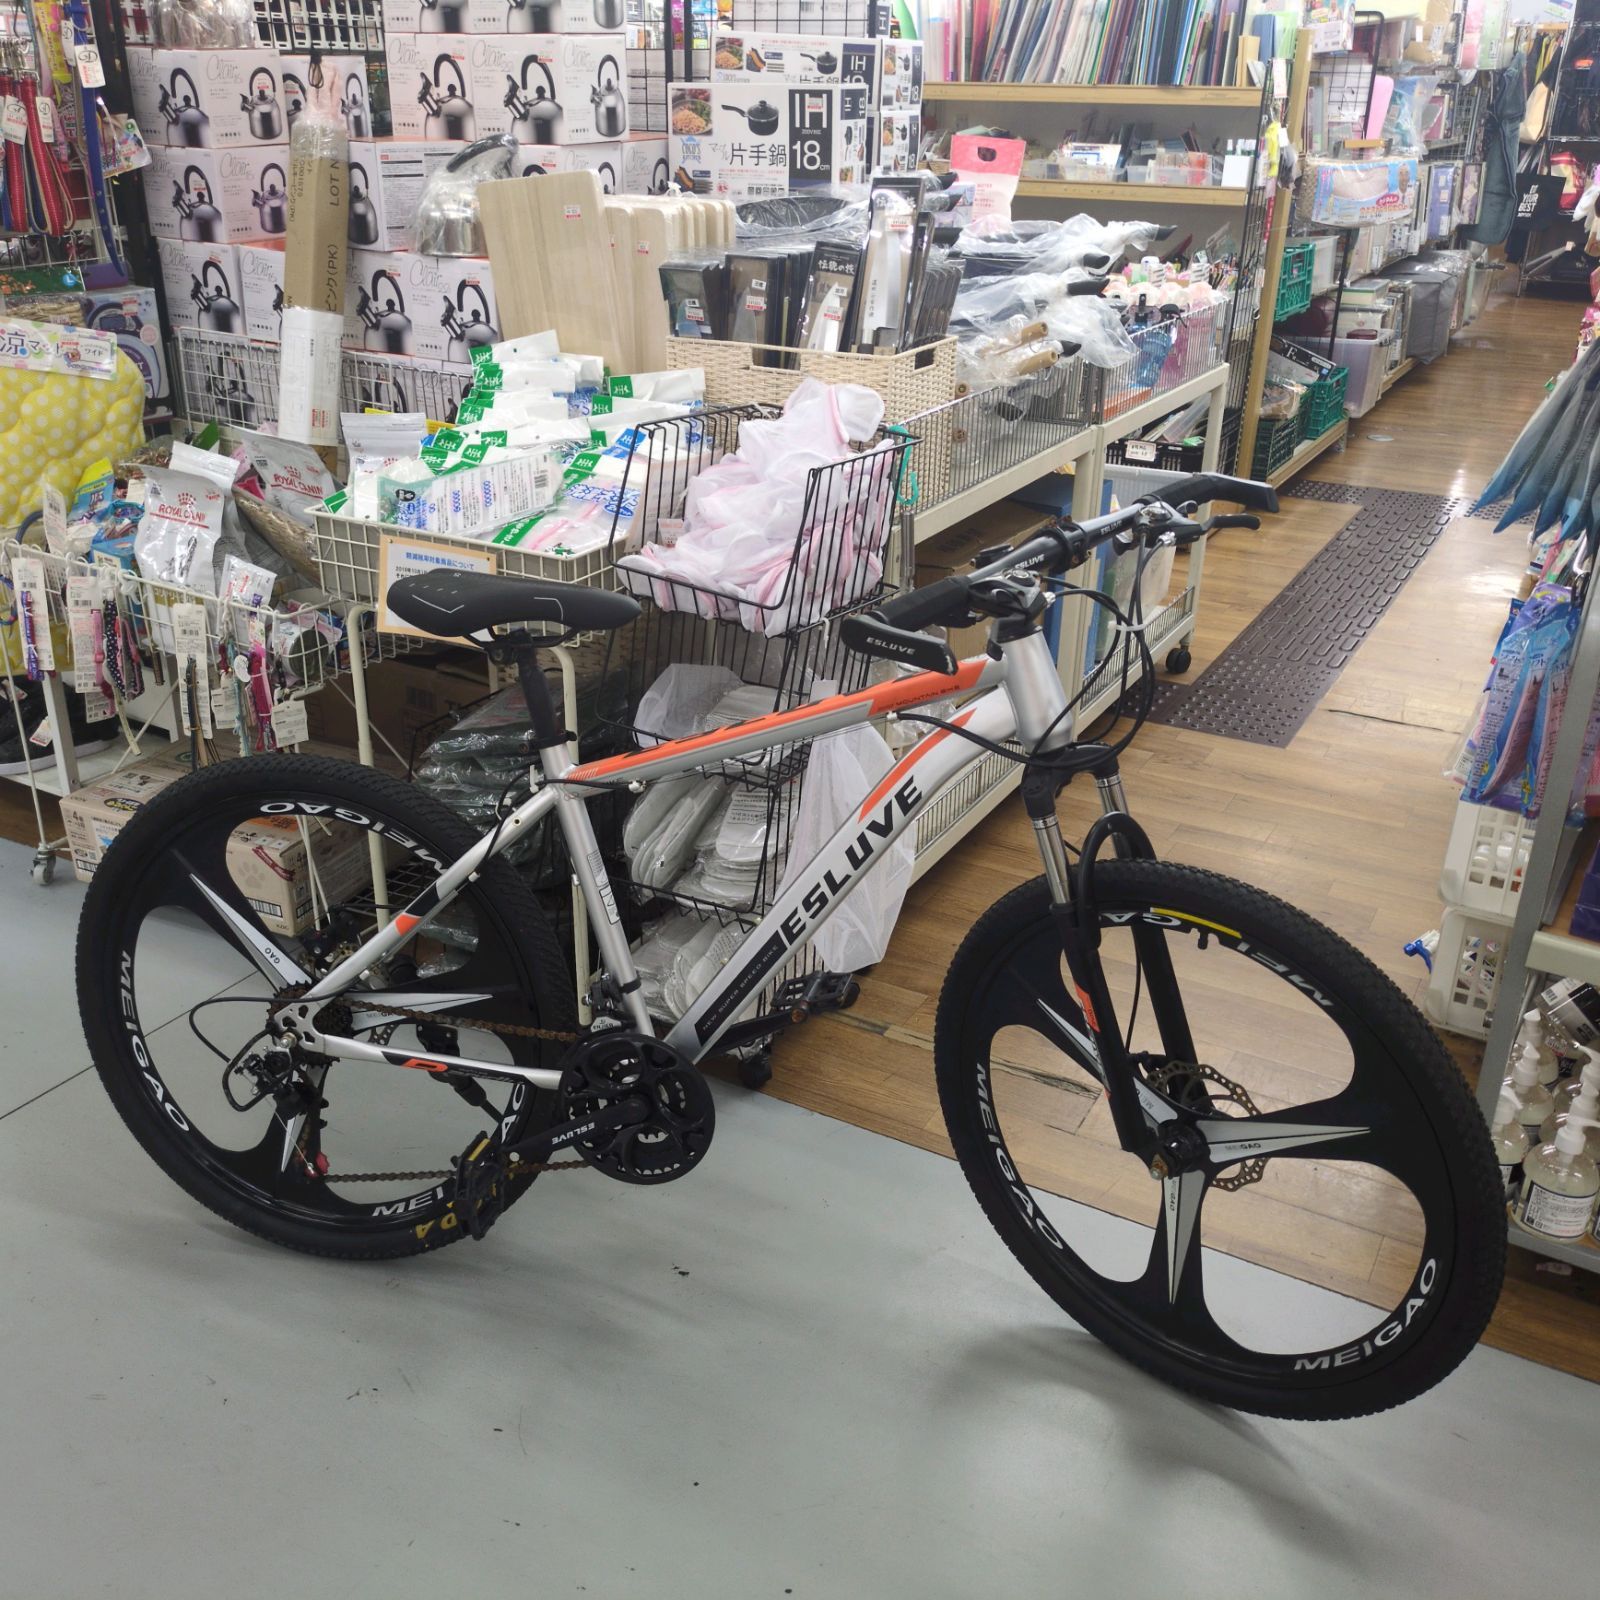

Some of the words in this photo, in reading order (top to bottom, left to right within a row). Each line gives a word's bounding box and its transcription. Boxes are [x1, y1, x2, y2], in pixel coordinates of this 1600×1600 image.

[795, 92, 828, 129] IH
[729, 142, 788, 168] 片手鍋
[329, 174, 340, 207] LOT
[158, 503, 182, 519] ROYAL
[866, 636, 915, 656] ESLUVE
[780, 775, 923, 946] ESLUVE
[702, 1014, 719, 1032] NEW
[717, 988, 741, 1014] SUPER
[761, 943, 780, 963] BIKE
[119, 950, 190, 1132] MEIGAO
[551, 1121, 596, 1146] ESLUVE
[976, 1062, 1065, 1250] MEIGAO
[1294, 1257, 1437, 1371] MEIGAO
